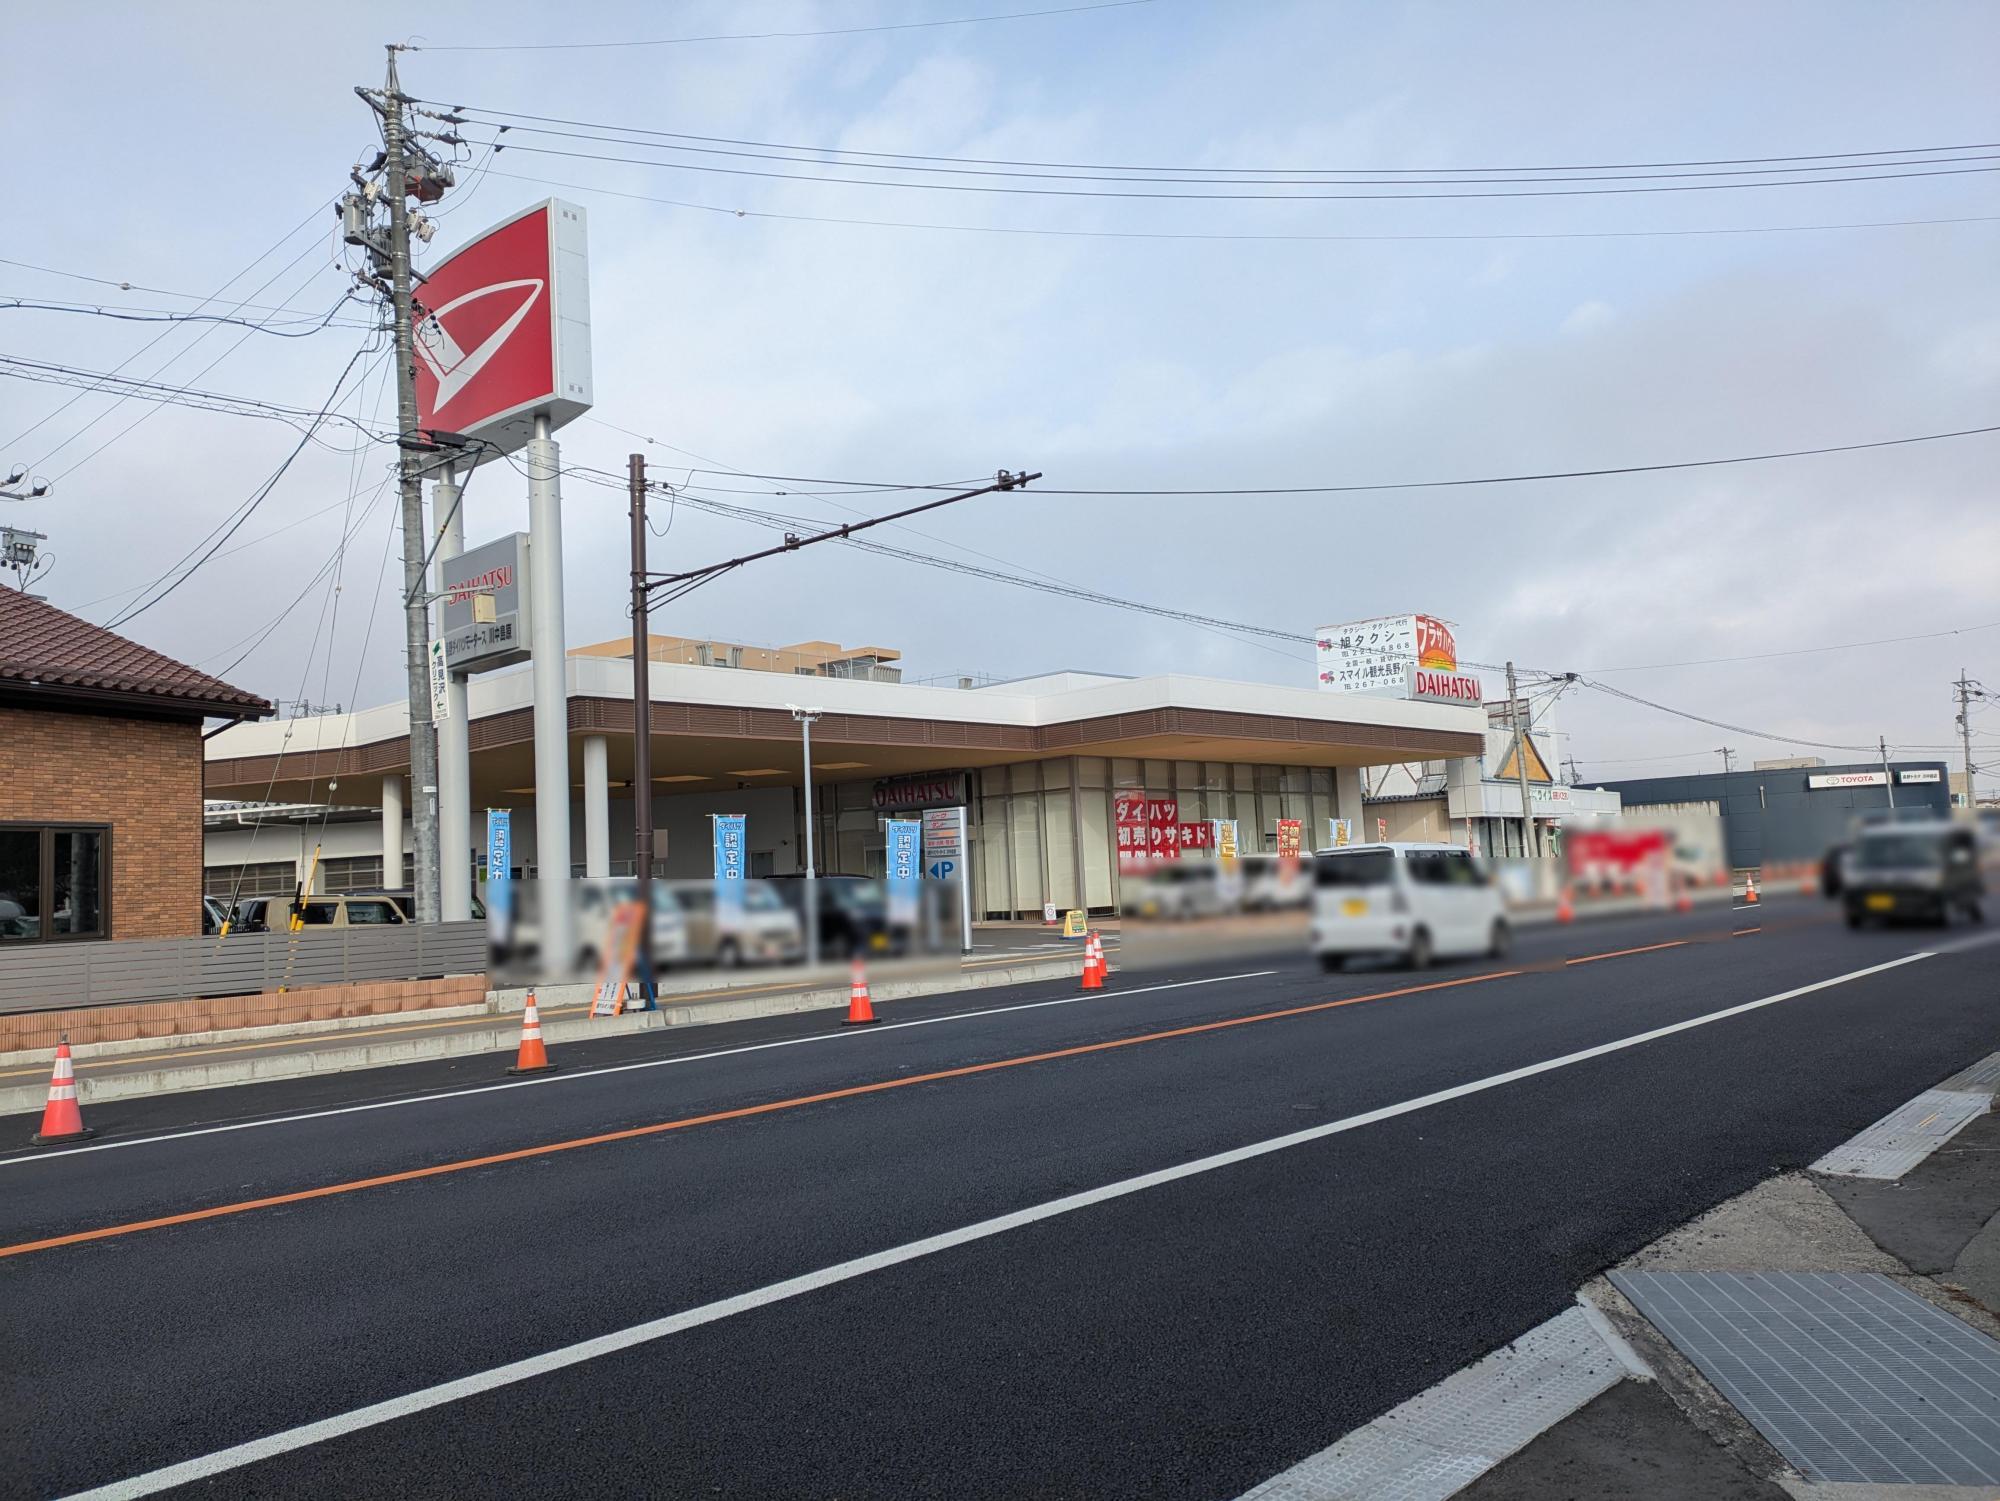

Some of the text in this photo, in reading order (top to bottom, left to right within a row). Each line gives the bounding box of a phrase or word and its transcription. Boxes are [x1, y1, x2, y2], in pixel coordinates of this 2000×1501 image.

[448, 565, 512, 606] DAIHATSU
[1340, 631, 1410, 649] 旭タクシー
[431, 661, 439, 701] クリニック
[436, 655, 446, 695] 高見沢
[1354, 676, 1405, 689] 267-068
[1416, 671, 1481, 701] DAIHATSU
[1840, 775, 1875, 783] TOYOTA
[875, 780, 956, 807] DAIHATSU
[1117, 802, 1176, 821] ダイハツ
[941, 861, 954, 879] P
